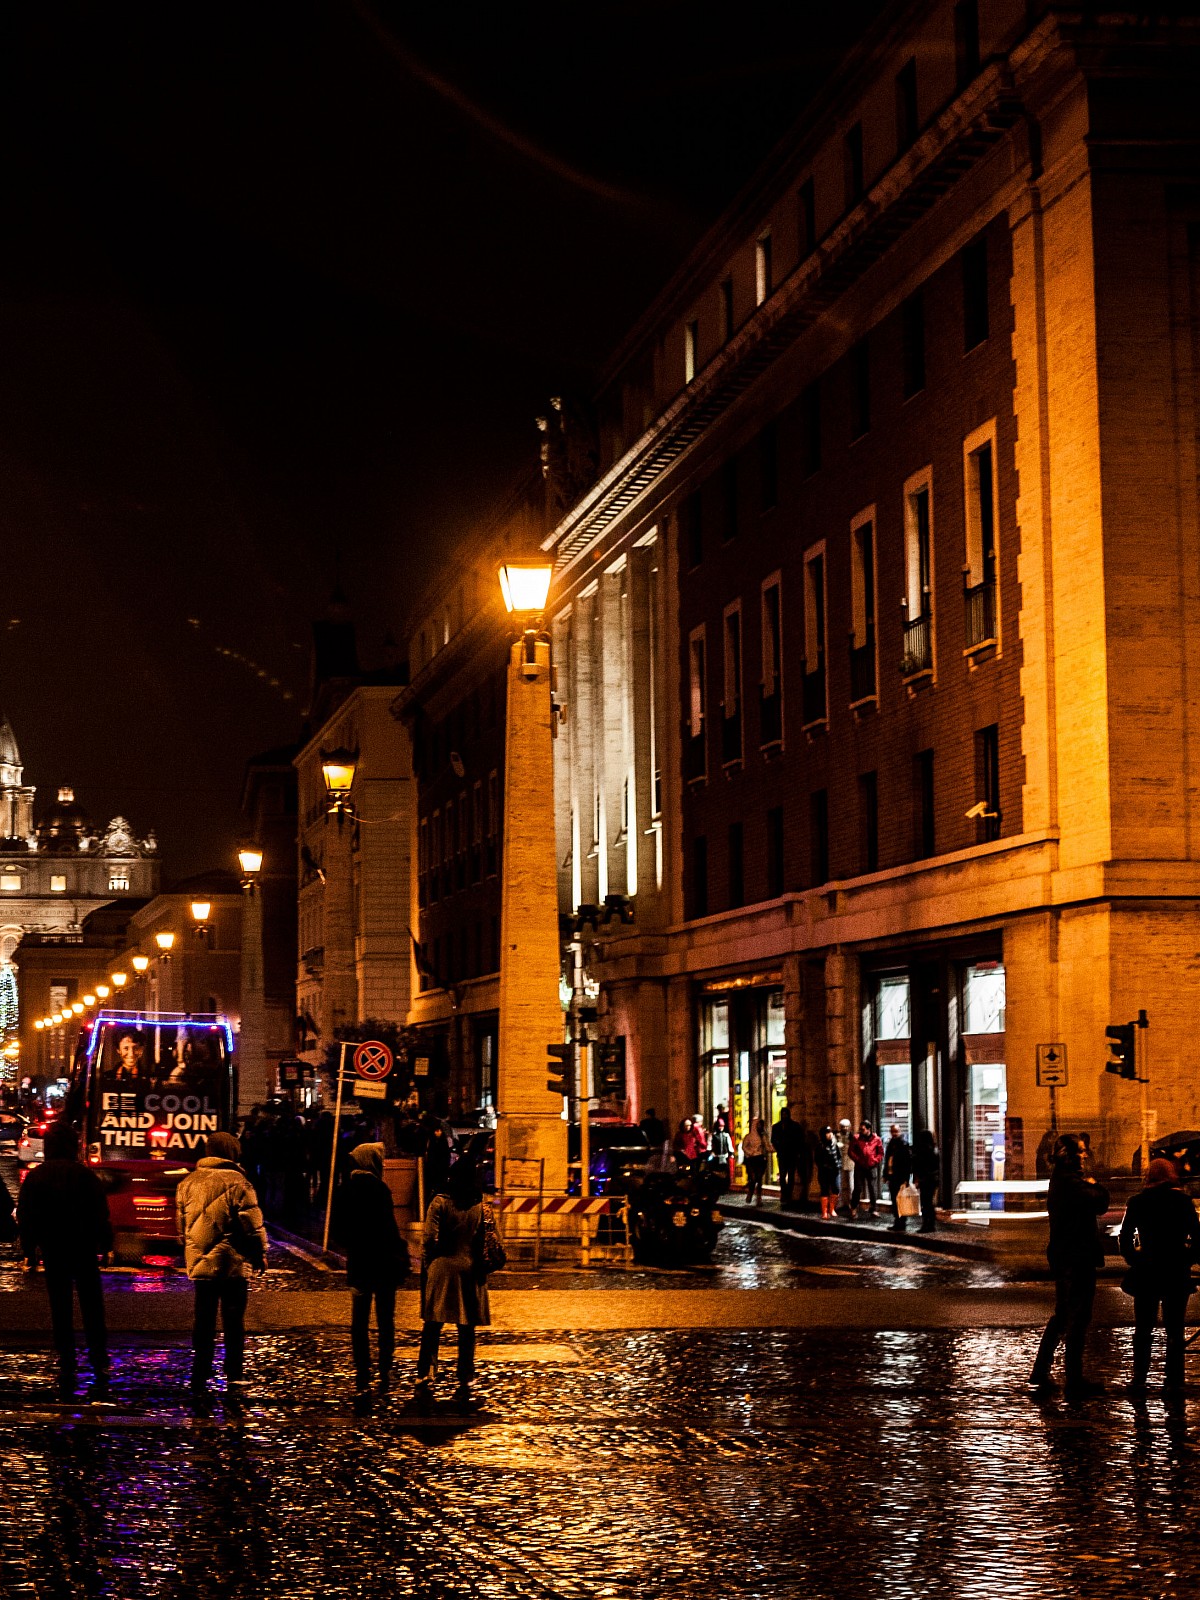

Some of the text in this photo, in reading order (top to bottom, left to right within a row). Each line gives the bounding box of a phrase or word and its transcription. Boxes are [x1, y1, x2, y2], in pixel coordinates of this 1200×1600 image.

[102, 1092, 217, 1114] BE COOL
[100, 1111, 218, 1131] AND JOIN
[100, 1130, 146, 1147] THE
